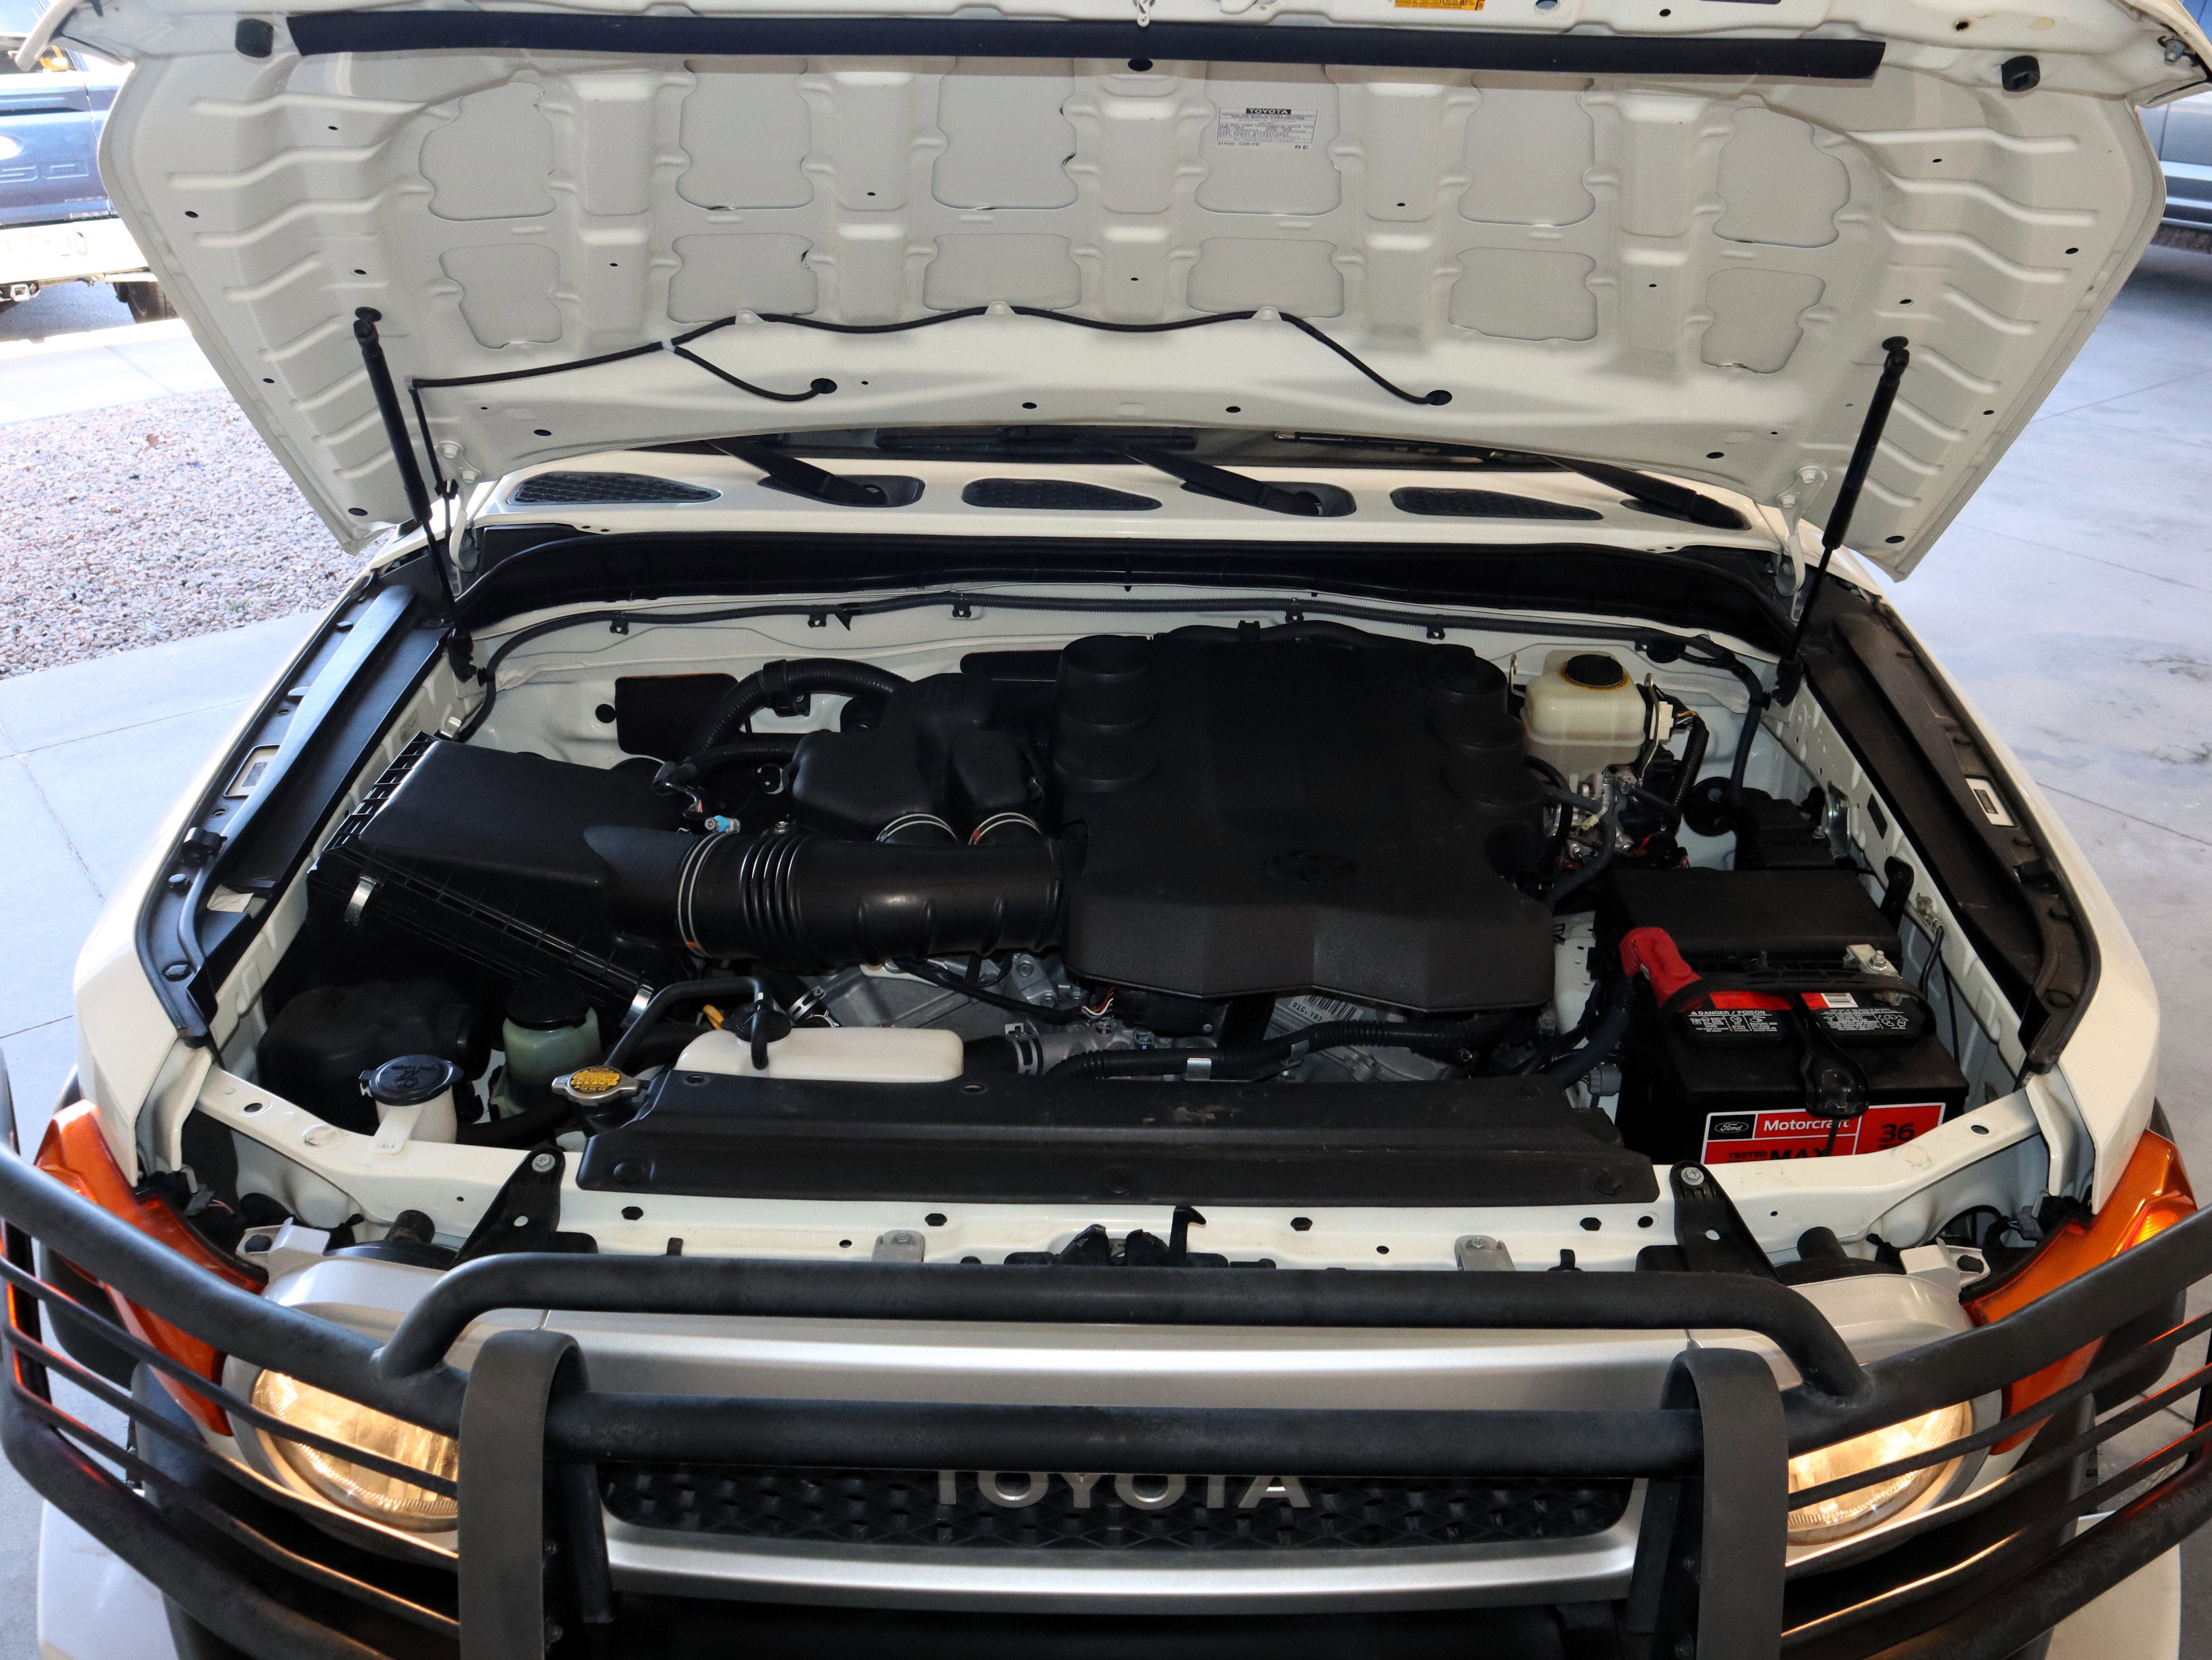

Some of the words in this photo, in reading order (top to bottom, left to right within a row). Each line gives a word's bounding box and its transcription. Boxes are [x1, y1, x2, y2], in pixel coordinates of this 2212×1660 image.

[1721, 1123, 1742, 1131] Ford
[1879, 1123, 1915, 1142] 36
[1729, 1151, 1767, 1159] TESTED
[938, 1471, 1311, 1510] TOYOTA
